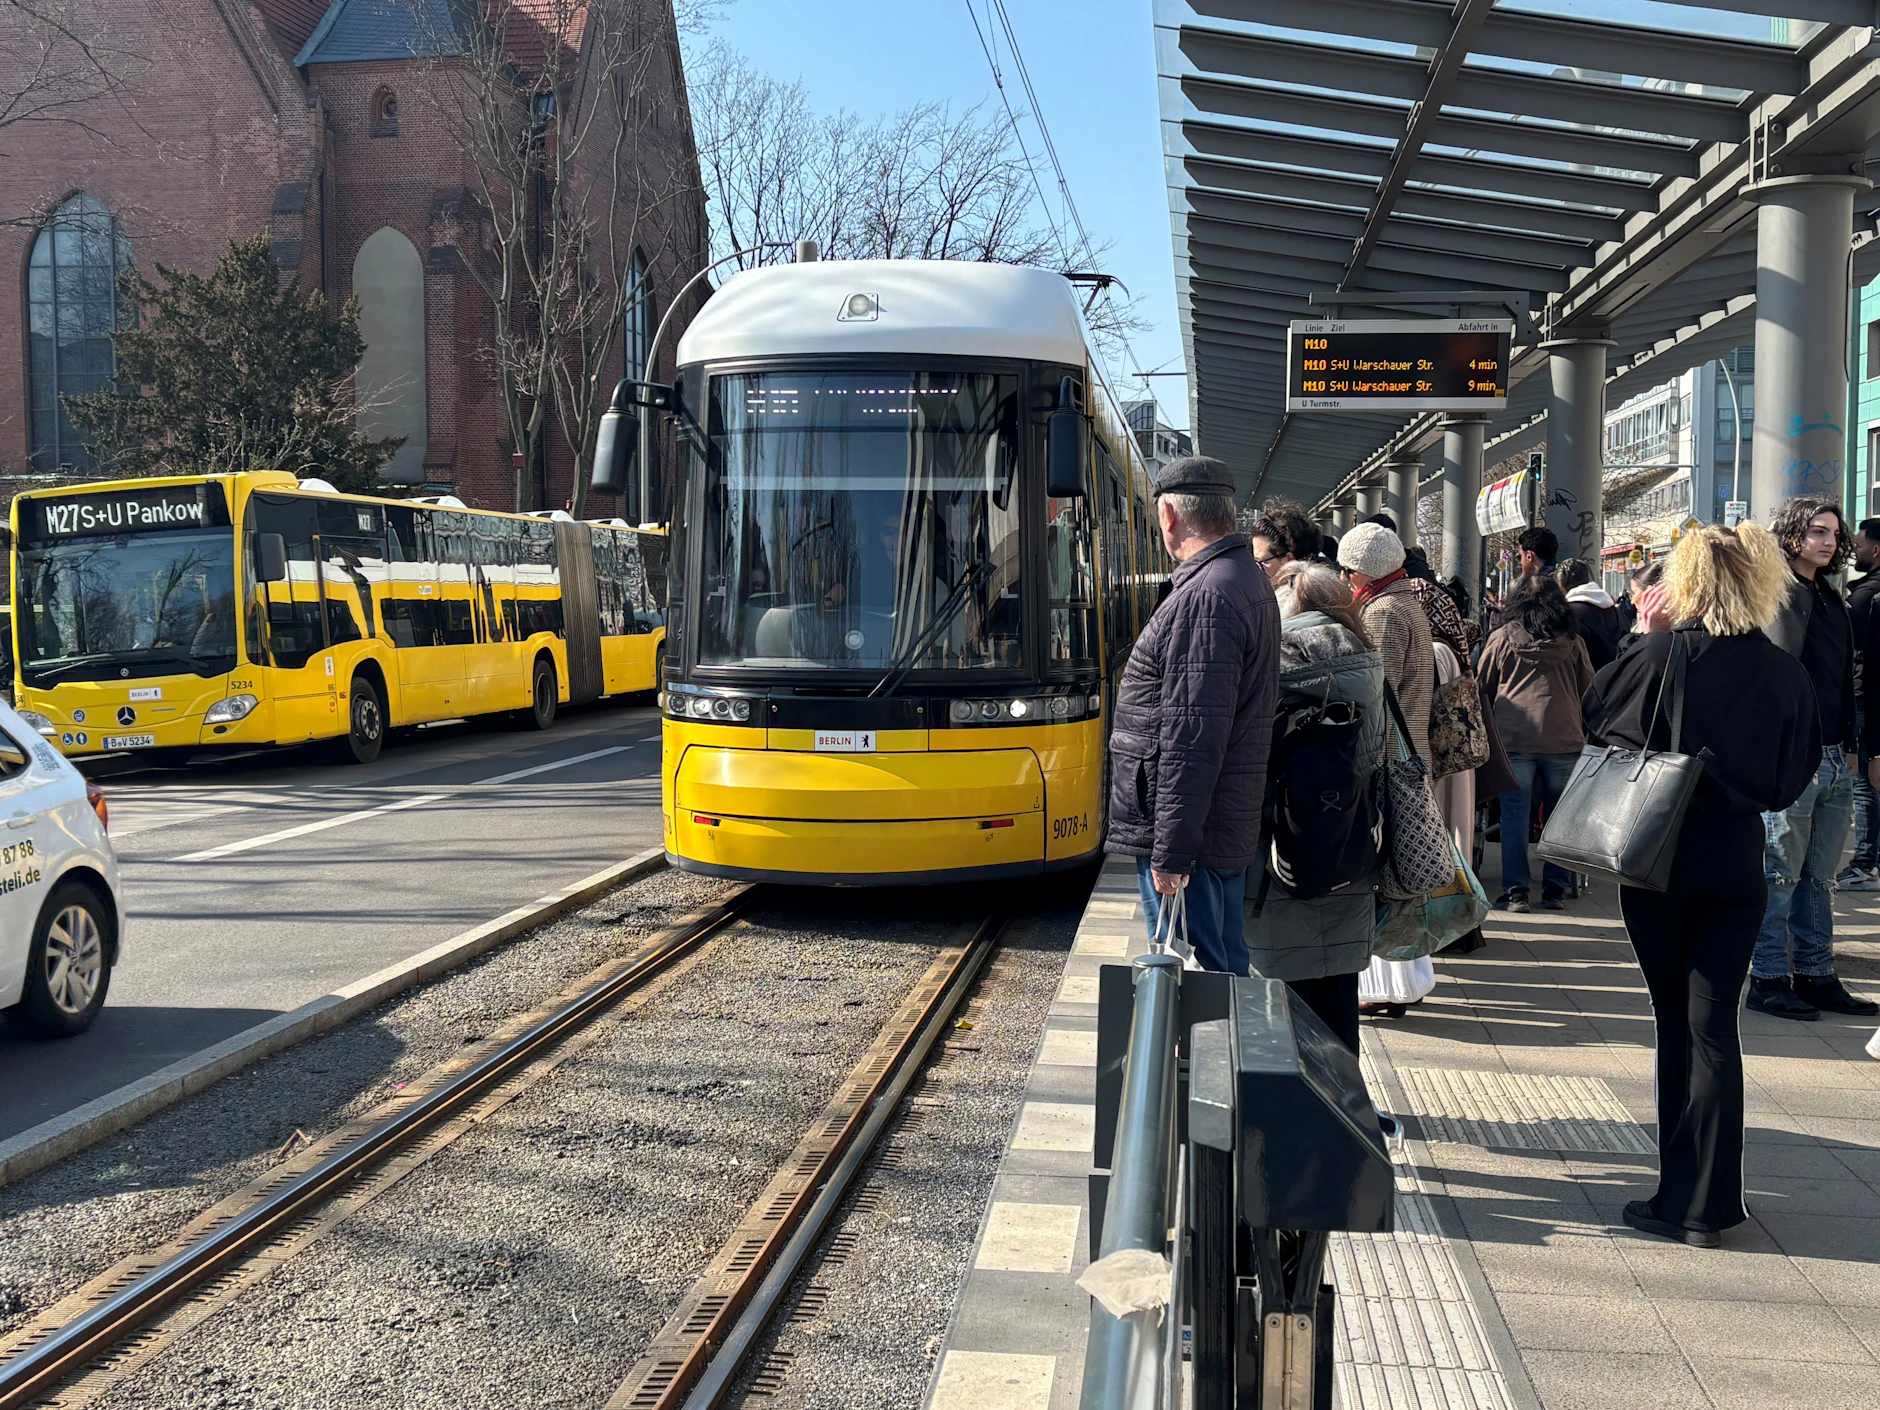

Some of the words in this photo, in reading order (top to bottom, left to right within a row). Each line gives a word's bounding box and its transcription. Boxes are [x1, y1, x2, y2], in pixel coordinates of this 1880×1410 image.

[1305, 324, 1324, 332] Linie
[1331, 324, 1346, 332] Ziel
[1458, 323, 1489, 331] Abfahrt
[1490, 323, 1499, 331] in
[1304, 339, 1328, 350] M10
[1303, 359, 1327, 371] M10
[1330, 360, 1350, 371] S+U
[1353, 359, 1413, 371] Warschauer
[1416, 359, 1434, 371] Str.
[1469, 359, 1476, 370] 4
[1478, 359, 1498, 370] min
[1303, 380, 1326, 392] M10
[1329, 380, 1349, 392] S+U
[1352, 380, 1412, 392] Warschauer
[1415, 380, 1433, 392] Str.
[1467, 380, 1476, 391] 9
[1476, 380, 1497, 391] min
[1302, 400, 1307, 408] U
[1310, 400, 1342, 408] Turmstr.
[46, 504, 78, 534] M27
[81, 503, 122, 529] S+U
[126, 499, 203, 525] Pankow
[357, 513, 371, 530] M27
[231, 680, 253, 689] 5234
[111, 738, 117, 747] B
[122, 737, 128, 746] V
[129, 736, 151, 746] 5234
[819, 737, 851, 745] BERLIN
[1053, 812, 1088, 840] 9078-A
[3, 845, 16, 864] 87
[19, 839, 34, 858] 88
